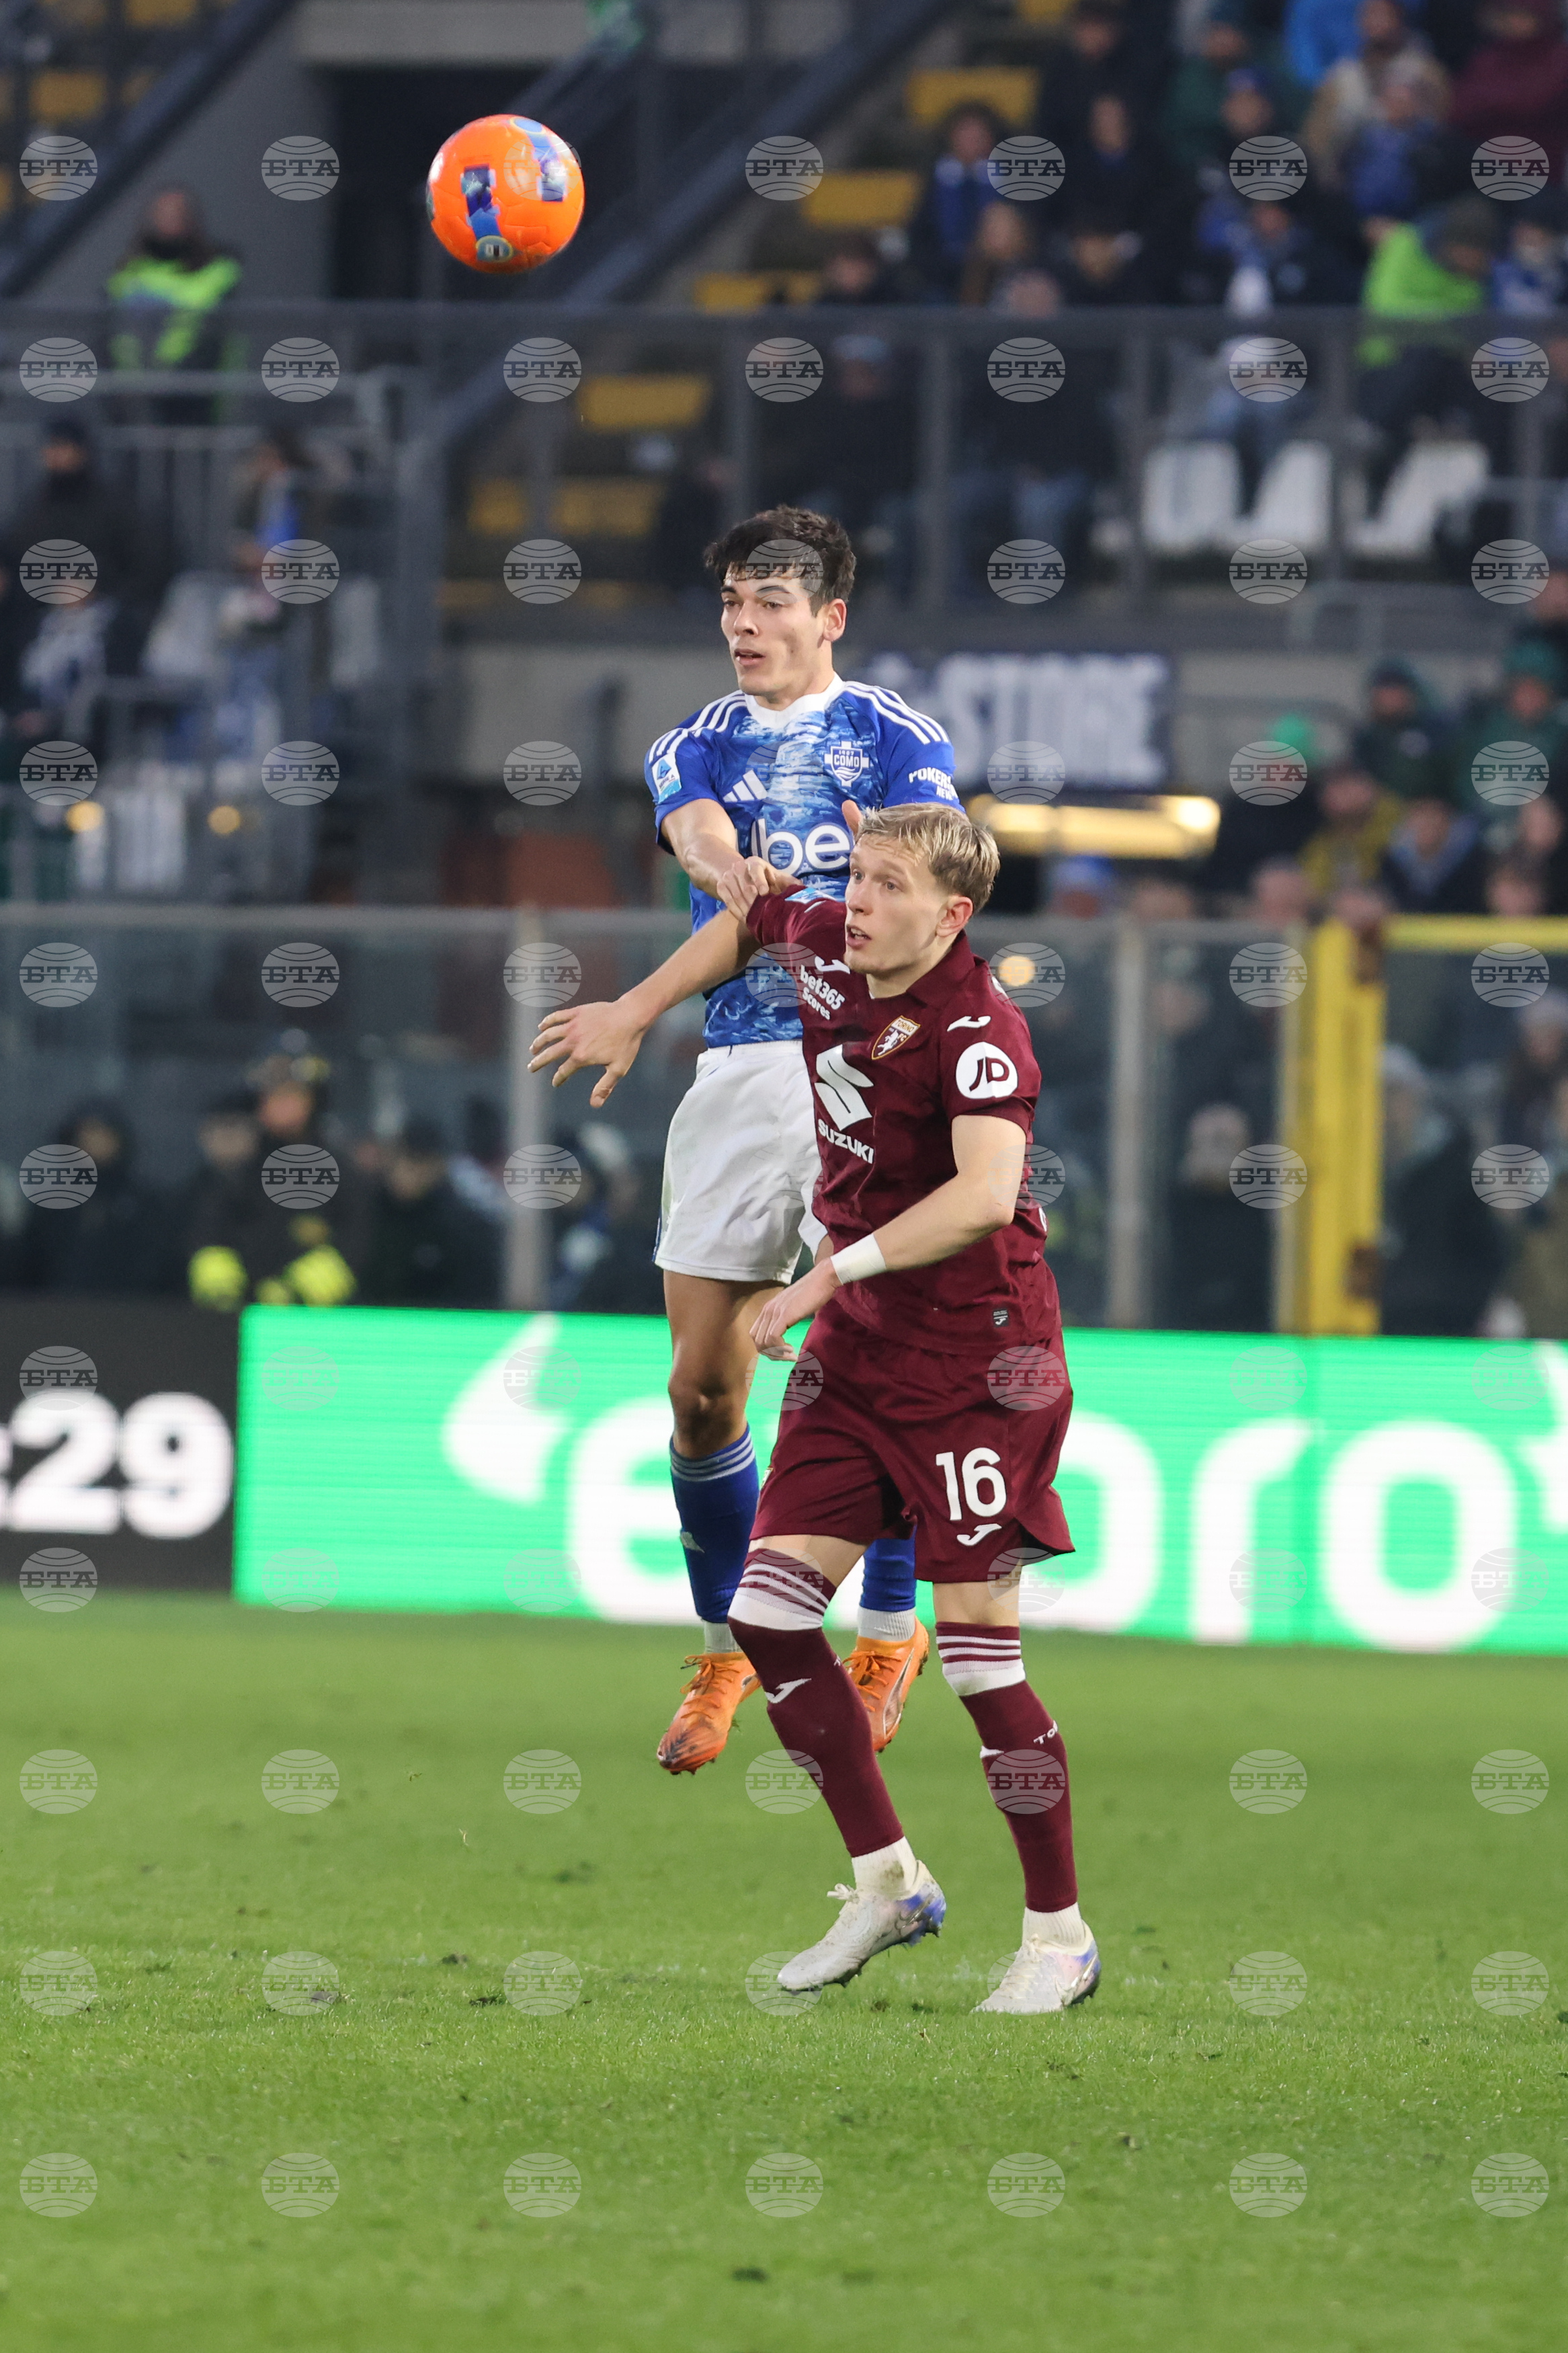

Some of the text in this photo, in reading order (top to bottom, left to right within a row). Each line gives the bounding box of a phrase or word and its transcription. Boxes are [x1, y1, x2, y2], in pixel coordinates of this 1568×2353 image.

[833, 754, 860, 768] COMO
[735, 817, 854, 875] be
[800, 964, 845, 1010] bet365
[802, 987, 831, 1020] Scores
[895, 1020, 915, 1033] TORINO
[897, 1033, 907, 1042] FC
[968, 1056, 1010, 1092] JD
[818, 1119, 874, 1164] SUZUKI
[0, 1389, 233, 1540] 29
[936, 1447, 1007, 1521] 16
[566, 1393, 1520, 1655] eoro
